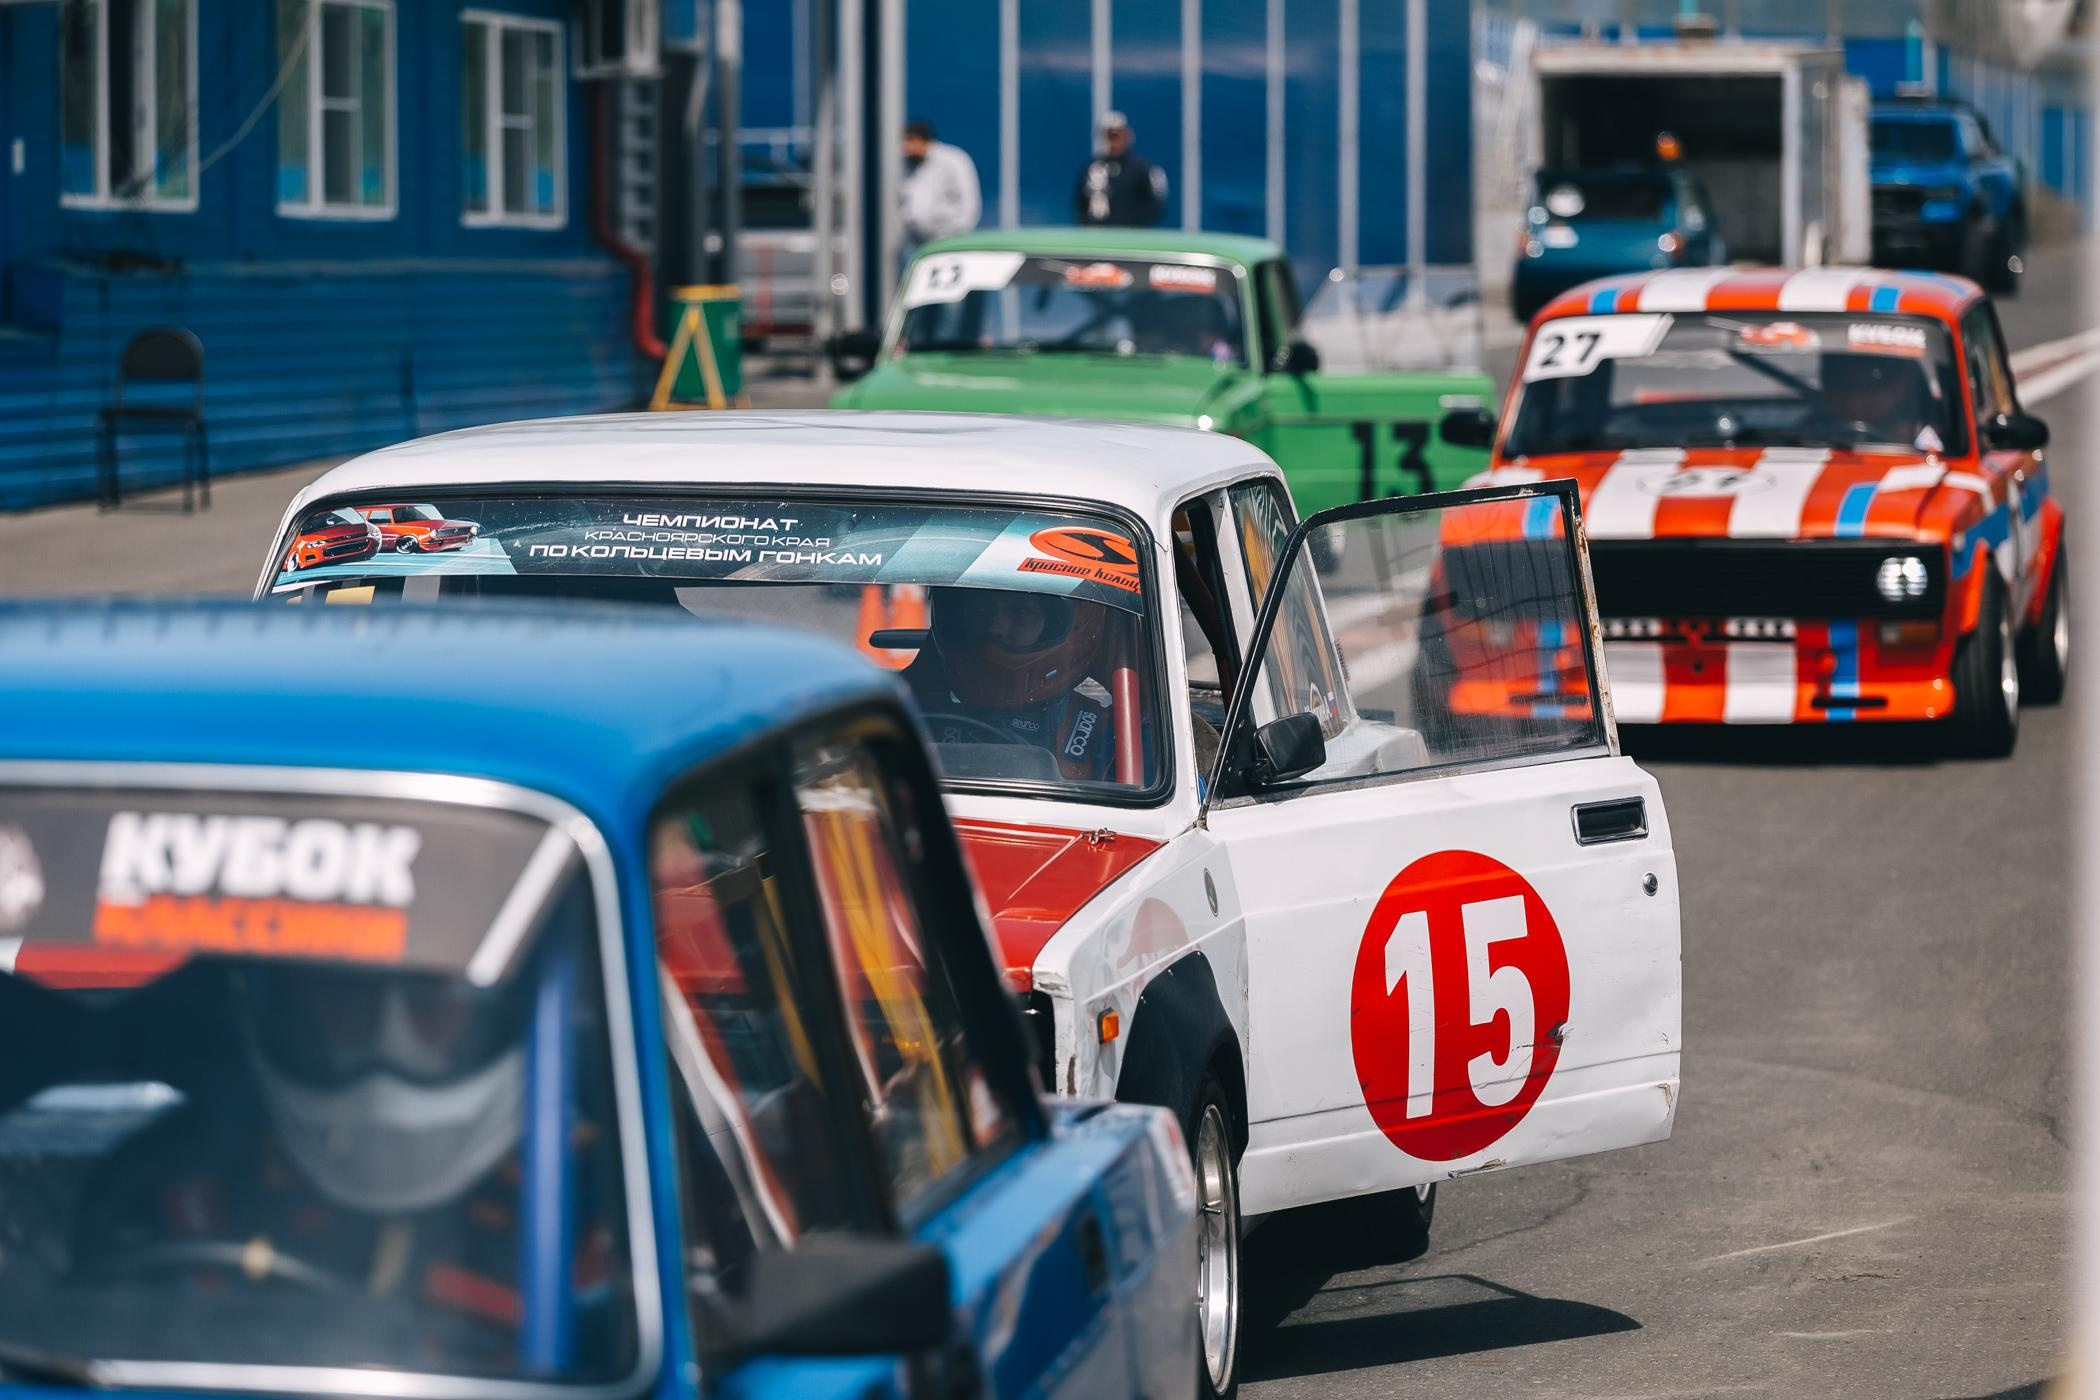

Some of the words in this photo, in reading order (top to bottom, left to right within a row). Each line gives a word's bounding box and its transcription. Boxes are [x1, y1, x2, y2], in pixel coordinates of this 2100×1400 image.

[1540, 331, 1602, 367] 27
[1351, 421, 1435, 501] 13
[584, 531, 769, 546] КРАСНОЯРСКОГО
[772, 536, 831, 548] КРАЯ
[623, 513, 799, 531] ЧЕМПИОНАТ
[529, 545, 567, 557] ПО
[571, 545, 754, 562] КОЛЬЦЕВЫМ
[758, 548, 882, 566] ГОНКАМ
[1011, 718, 1040, 731] sparco
[1068, 711, 1098, 757] sparco
[98, 812, 421, 906] КУБОК
[1384, 894, 1536, 1119] 15
